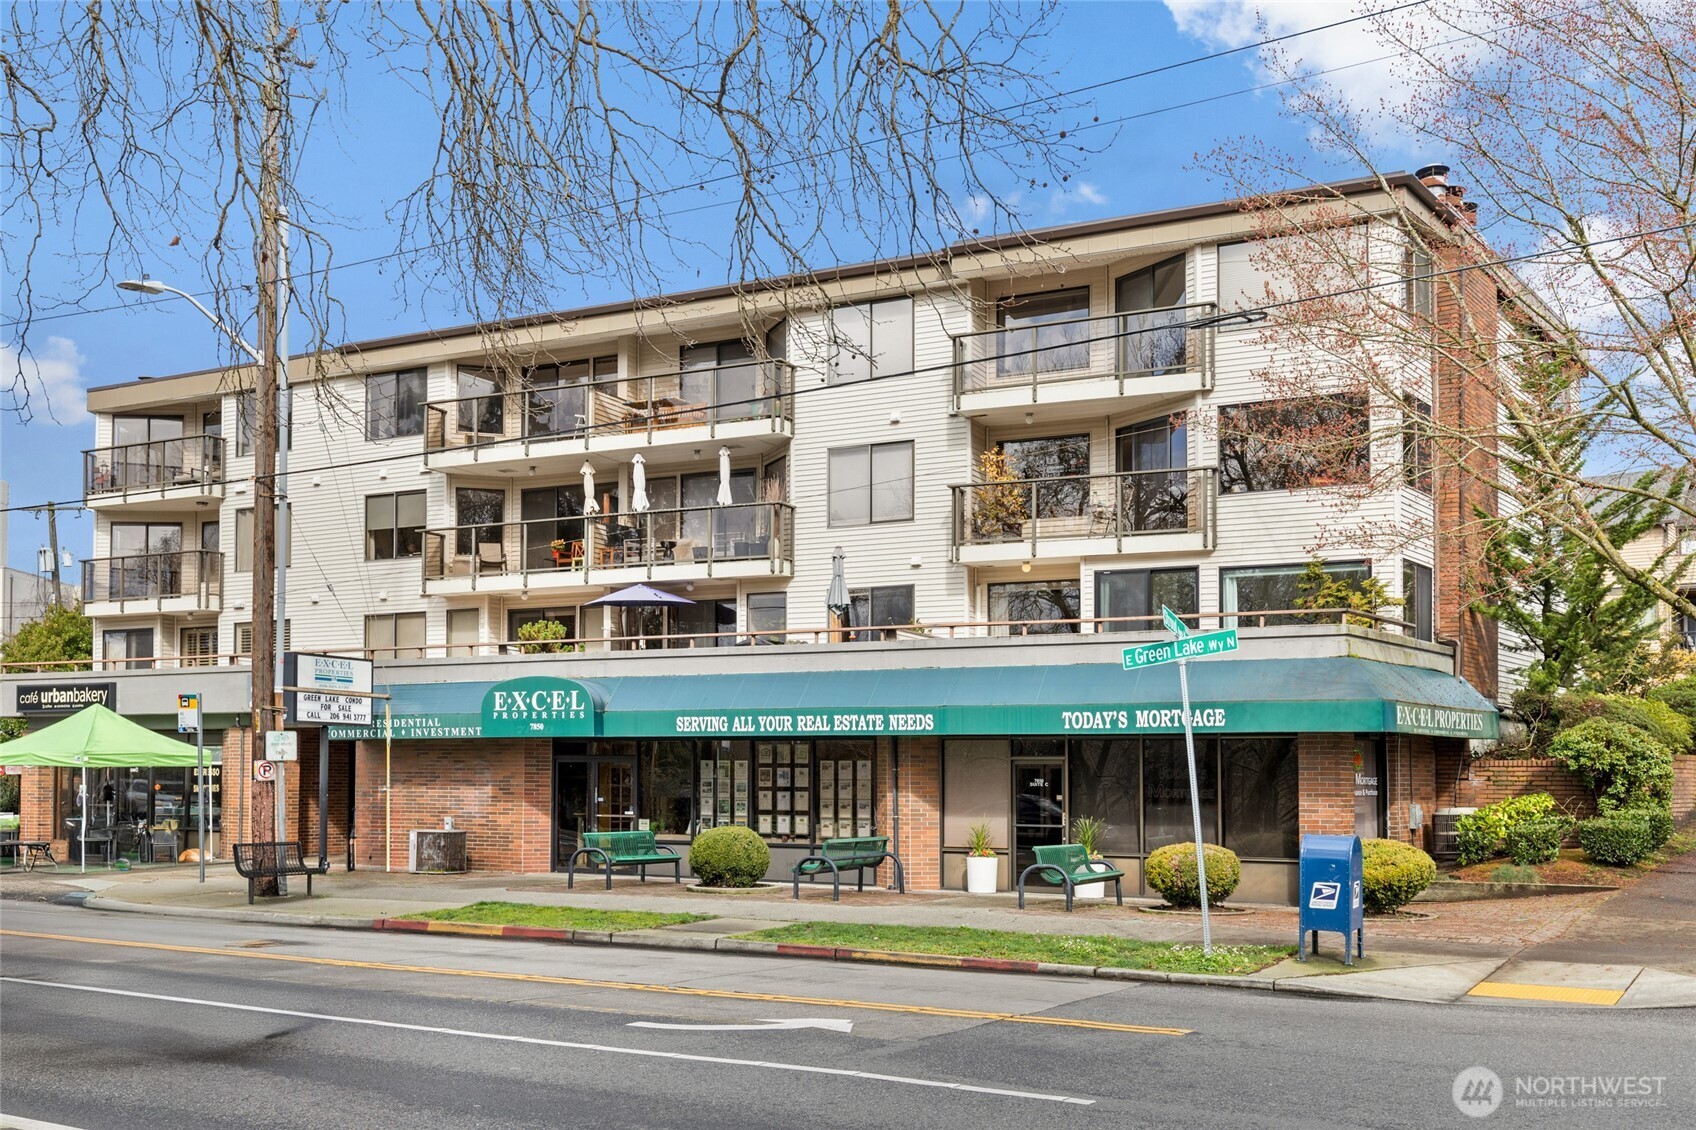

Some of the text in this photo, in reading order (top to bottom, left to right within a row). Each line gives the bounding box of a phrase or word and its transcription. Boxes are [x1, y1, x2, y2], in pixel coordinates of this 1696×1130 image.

[1126, 636, 1235, 666] E Green Lake Wy N
[315, 667, 353, 676] PROPERTIES
[20, 691, 38, 704] café
[303, 694, 321, 702] GREEN
[325, 695, 339, 703] LAKE
[321, 703, 351, 712] FOR SALE
[307, 711, 320, 719] CALL
[330, 712, 340, 720] 206
[493, 711, 585, 719] PROPERTIES
[1062, 711, 1128, 729] TODAY'S
[1434, 709, 1483, 731] PROPERTIES
[529, 723, 544, 731] 7850
[676, 714, 934, 732] SERVING ALL YOUR REAL ESTATE NEEDS
[328, 727, 482, 738] OMMERCIAL INVESTMENT
